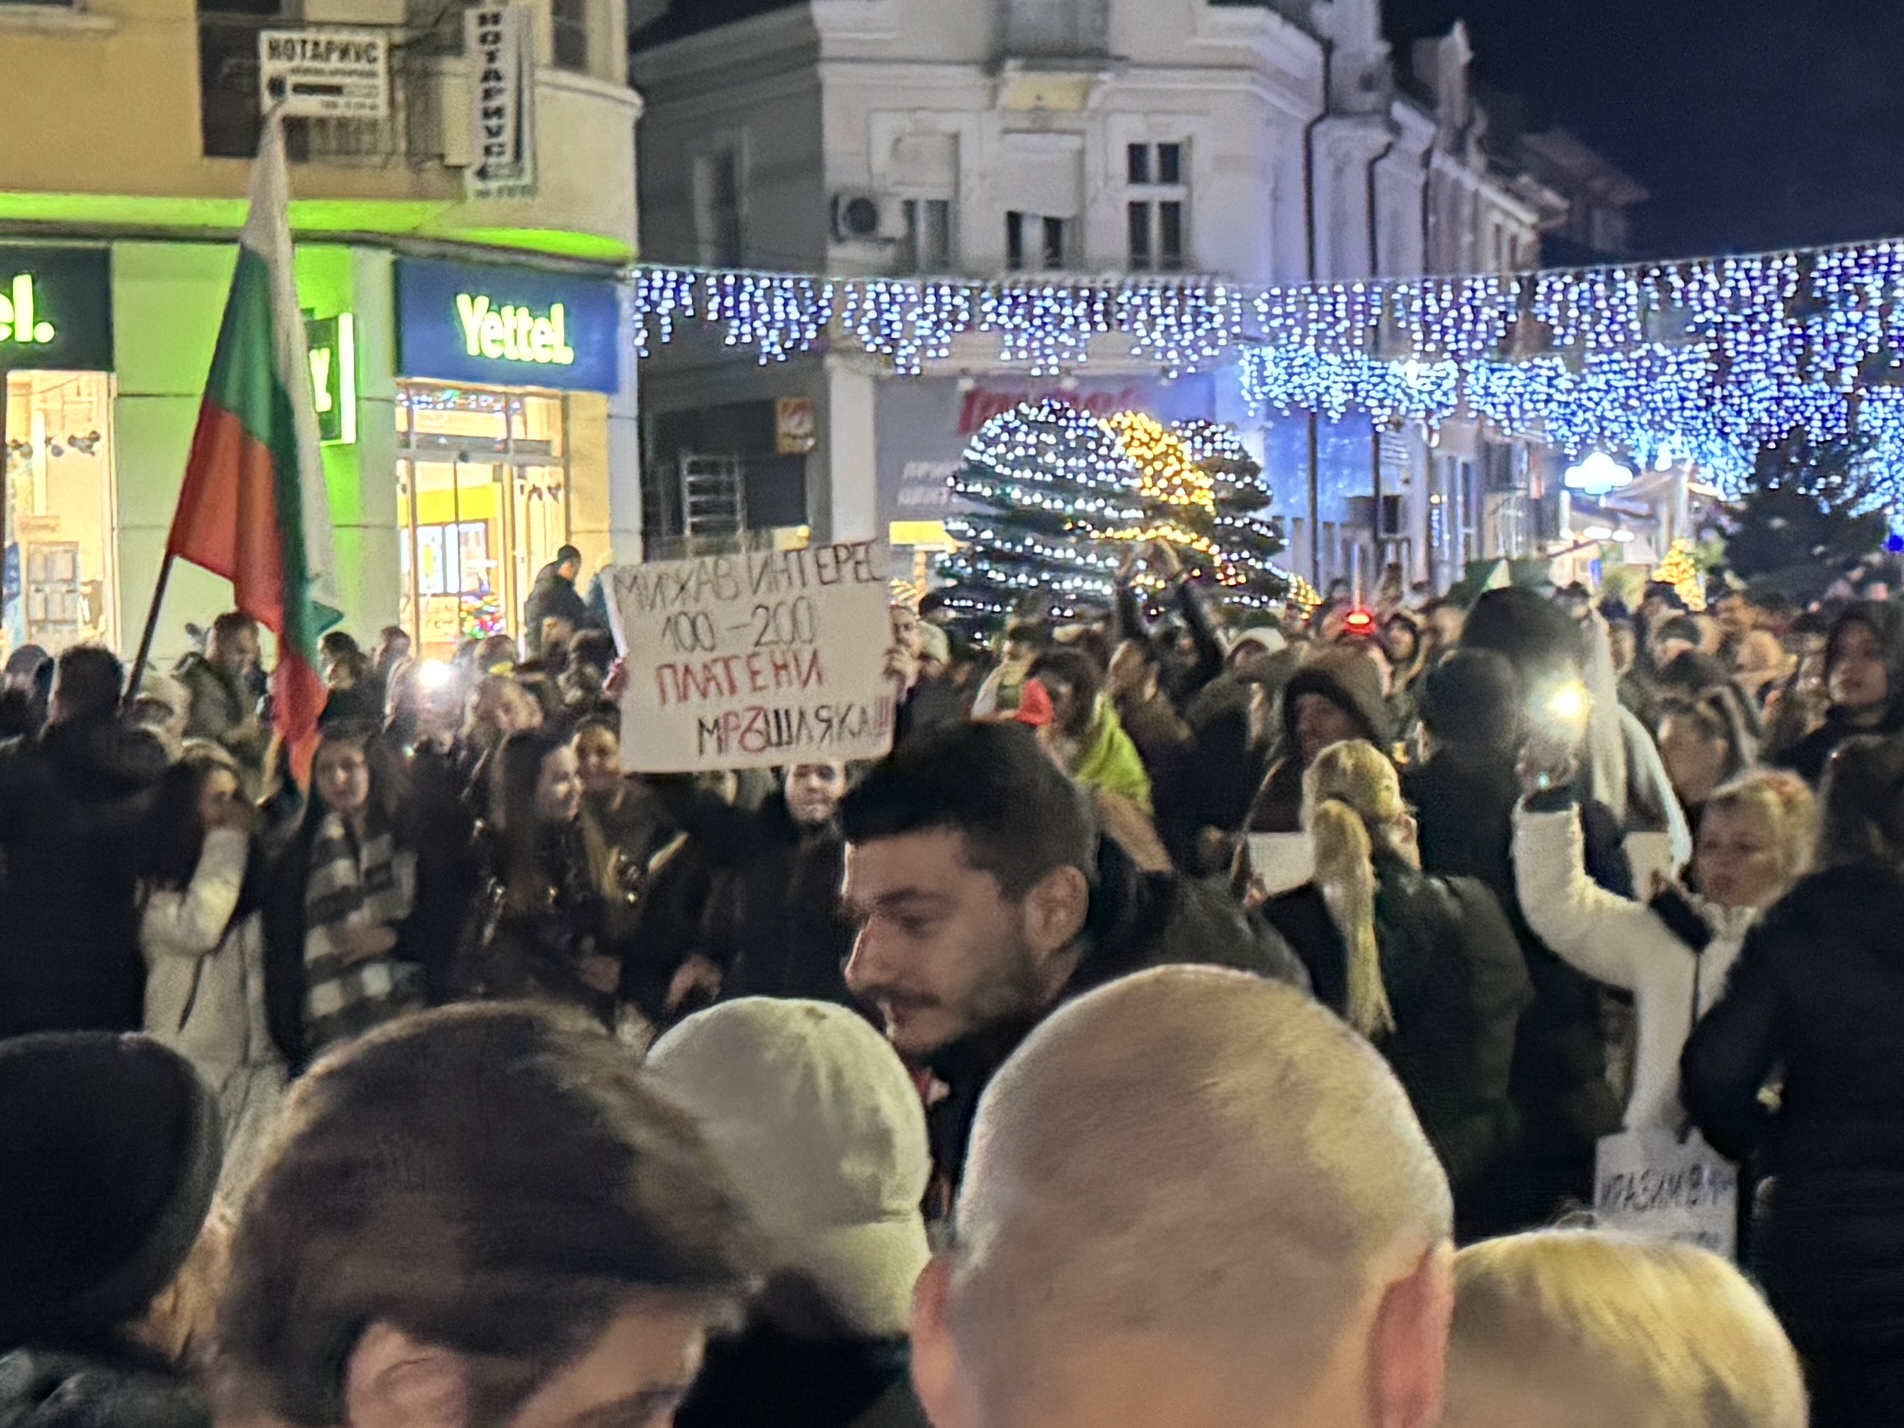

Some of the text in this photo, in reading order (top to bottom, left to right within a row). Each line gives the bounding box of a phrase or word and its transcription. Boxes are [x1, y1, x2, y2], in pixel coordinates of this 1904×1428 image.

[267, 38, 379, 65] НОТАРИУС
[477, 11, 507, 158] НОТАРИУС
[654, 648, 824, 706] ПЛАТЕНИ
